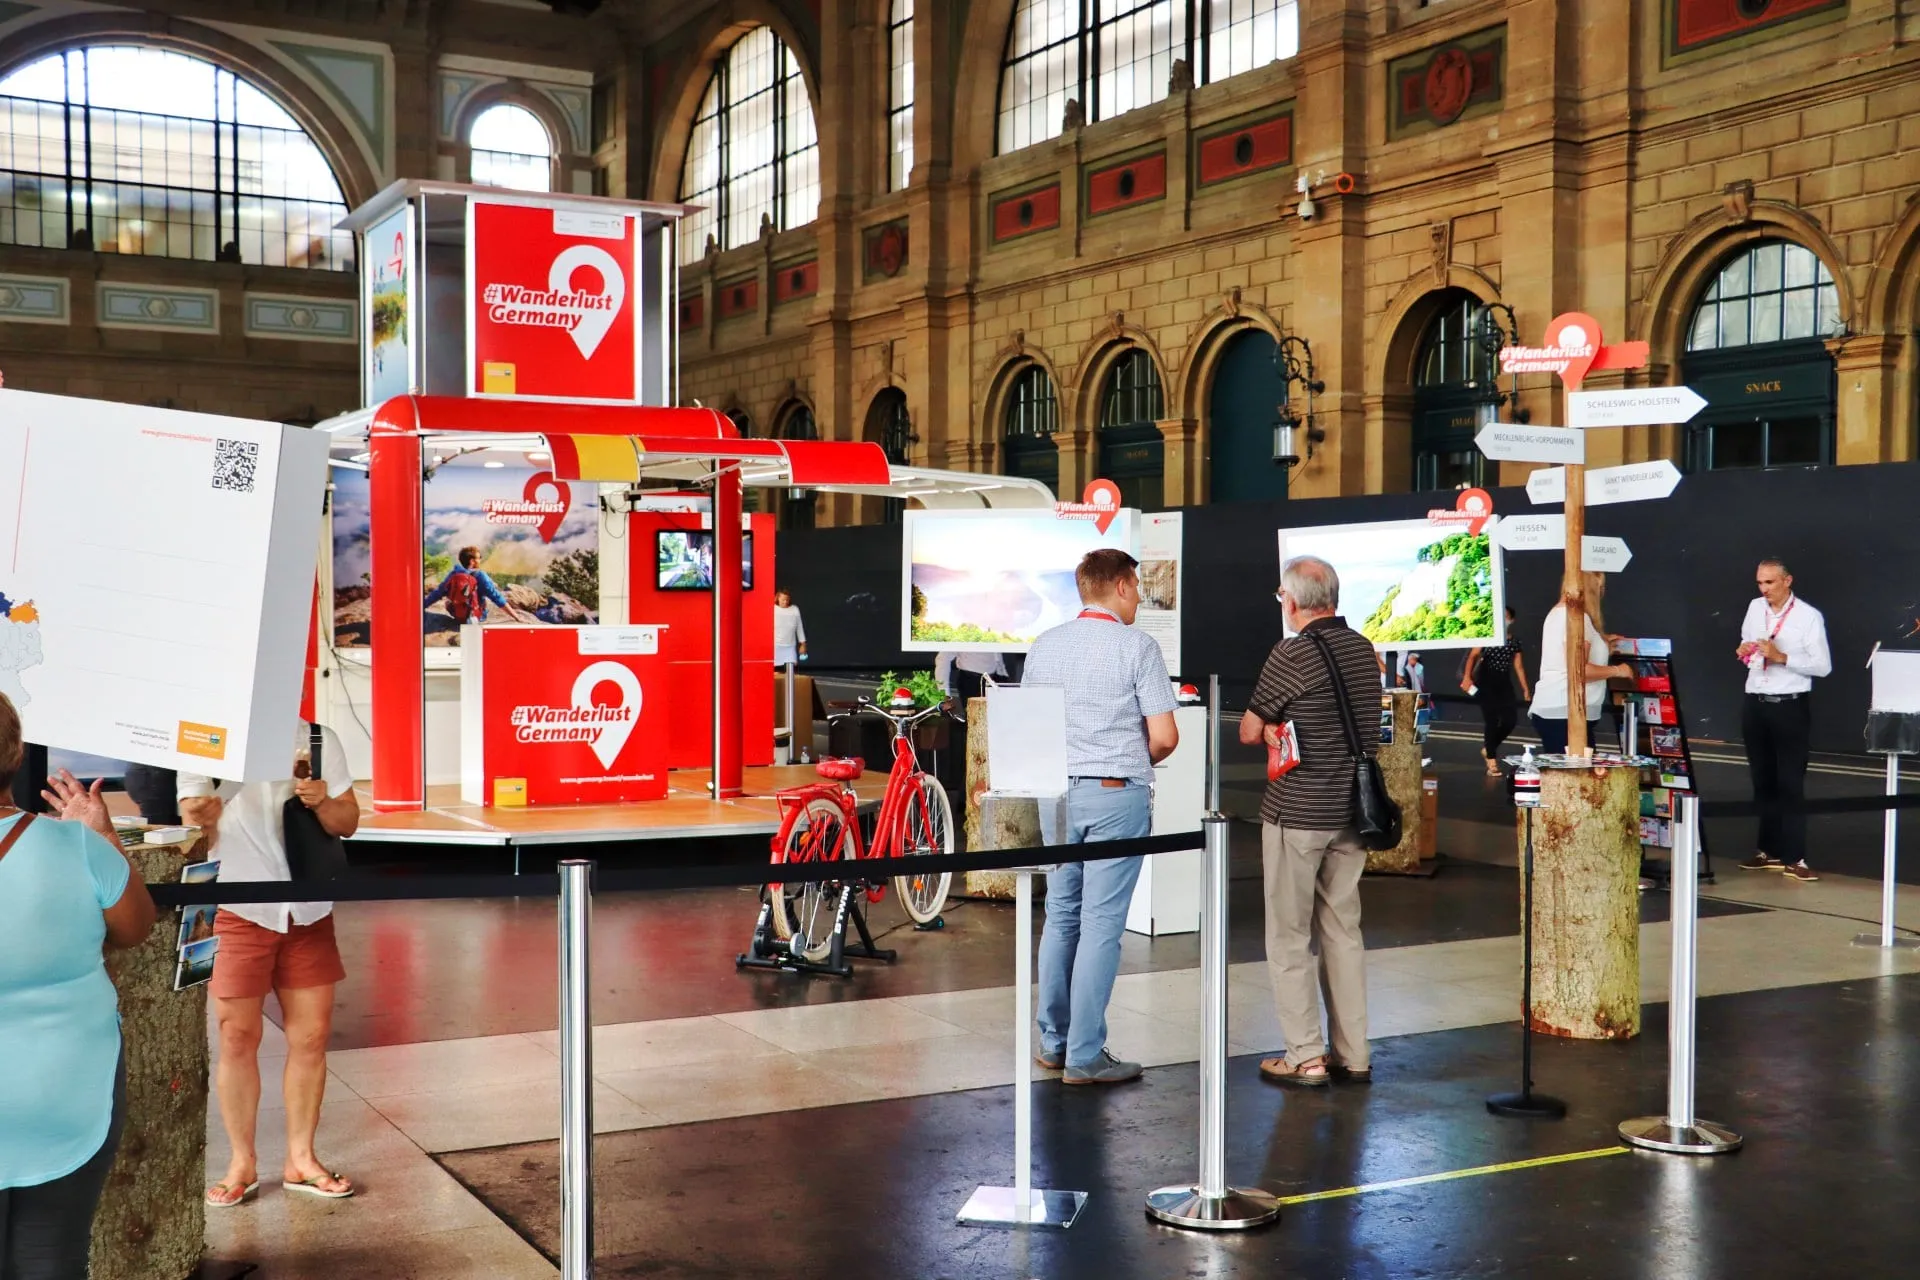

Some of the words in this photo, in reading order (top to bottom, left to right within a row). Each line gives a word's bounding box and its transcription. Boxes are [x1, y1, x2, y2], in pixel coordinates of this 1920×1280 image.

[485, 284, 613, 311] #Wanderlust
[490, 304, 583, 331] Germany
[1499, 344, 1592, 360] #Wanderlust
[1503, 360, 1570, 374] Germany
[1745, 380, 1782, 393] SNACK
[1587, 399, 1636, 408] SCHLESWIG
[1639, 397, 1680, 406] HOLSTEIN
[482, 500, 565, 512] #Wanderlust
[1054, 501, 1115, 511] #Wanderlust
[486, 512, 545, 528] Germany
[1056, 512, 1101, 523] Germany
[1427, 508, 1487, 519] #Wanderlust
[1431, 519, 1473, 528] Germany
[1516, 524, 1546, 532] HESSEN
[512, 704, 631, 724] #Wanderlust
[518, 726, 603, 745] Germany
